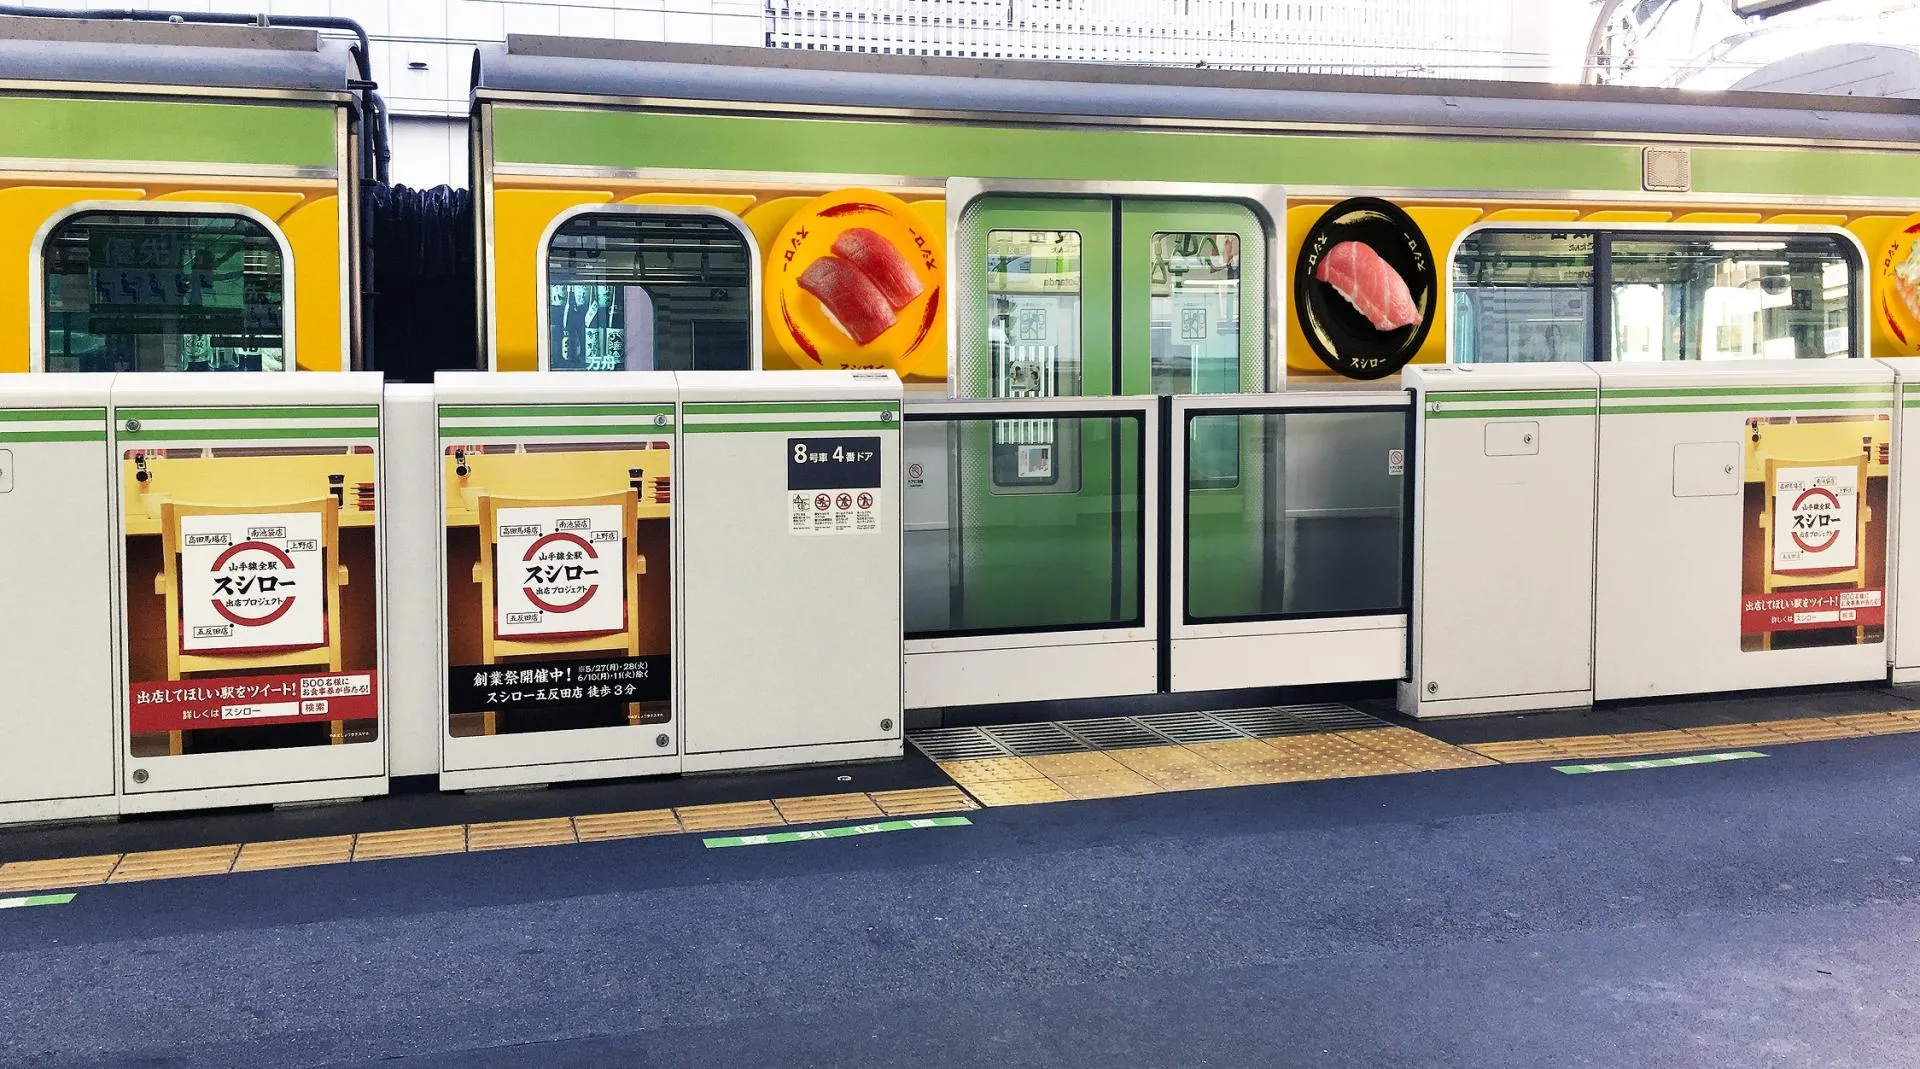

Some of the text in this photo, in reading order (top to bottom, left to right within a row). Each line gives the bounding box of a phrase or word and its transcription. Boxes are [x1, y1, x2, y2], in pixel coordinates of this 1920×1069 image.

[1350, 357, 1387, 369] スシロー
[794, 443, 874, 463] 8号車 4番ドア
[1792, 514, 1841, 529] スシロー
[539, 551, 583, 561] 山手線全駅
[228, 561, 278, 572] 山手線全駅
[524, 564, 599, 584] スシロー
[212, 575, 296, 597] スシロー
[536, 585, 588, 595] 出店プロジェクト
[225, 597, 284, 608] 出店プロジェクト
[303, 678, 349, 688] 500名様に
[473, 667, 571, 687] 創業祭開催中!
[137, 682, 297, 705] 出店してほしい駅をツイート!
[486, 686, 584, 704] スシロー五反田店
[183, 709, 219, 720] 詳しくは
[224, 707, 261, 718] スシロー
